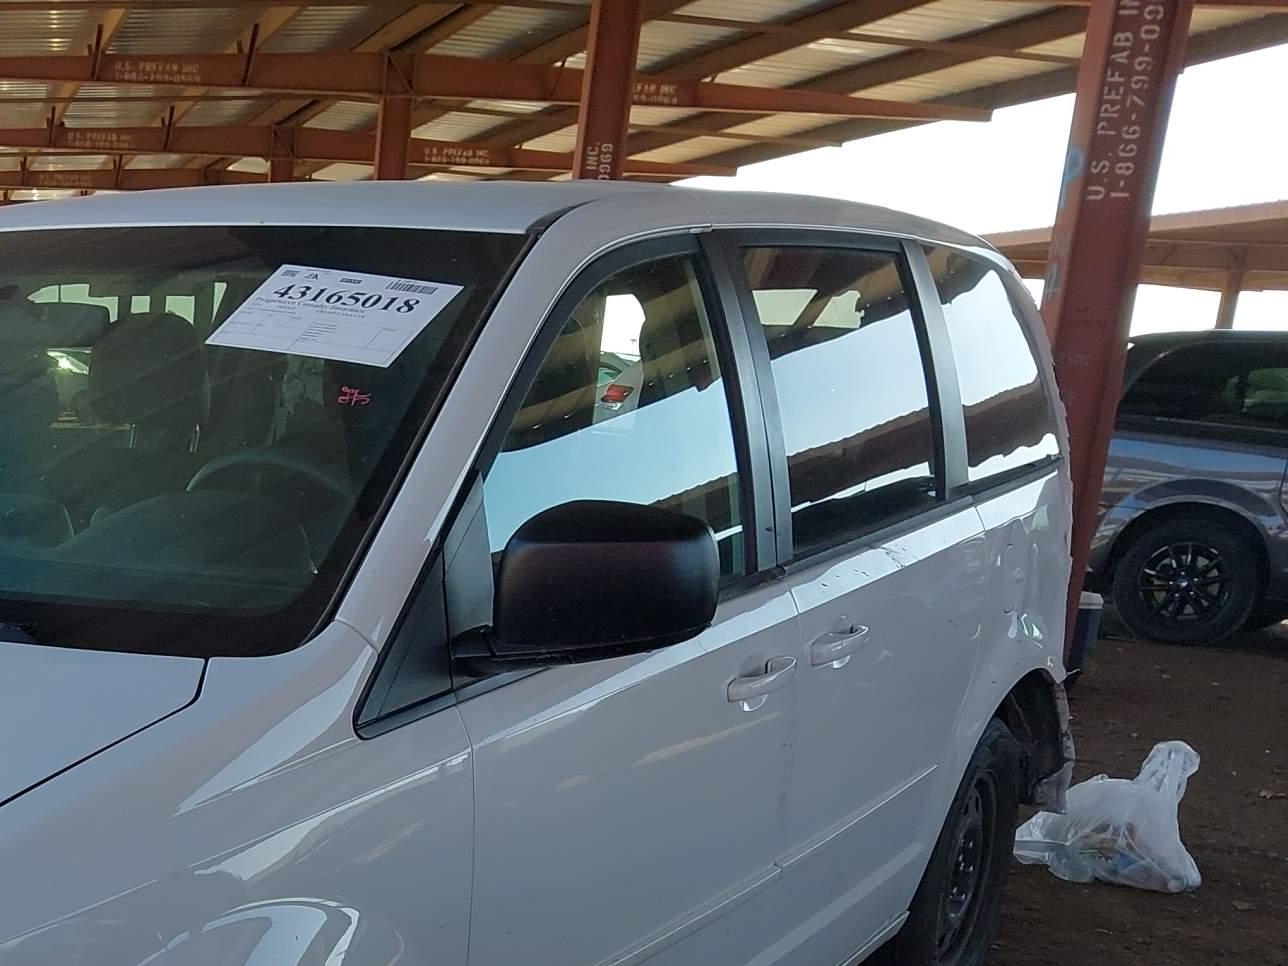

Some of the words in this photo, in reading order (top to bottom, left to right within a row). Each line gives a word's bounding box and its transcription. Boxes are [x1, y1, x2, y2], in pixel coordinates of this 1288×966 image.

[1096, 31, 1134, 136] PREFAB
[1088, 152, 1113, 200] U.S.
[273, 284, 420, 313] 43165018
